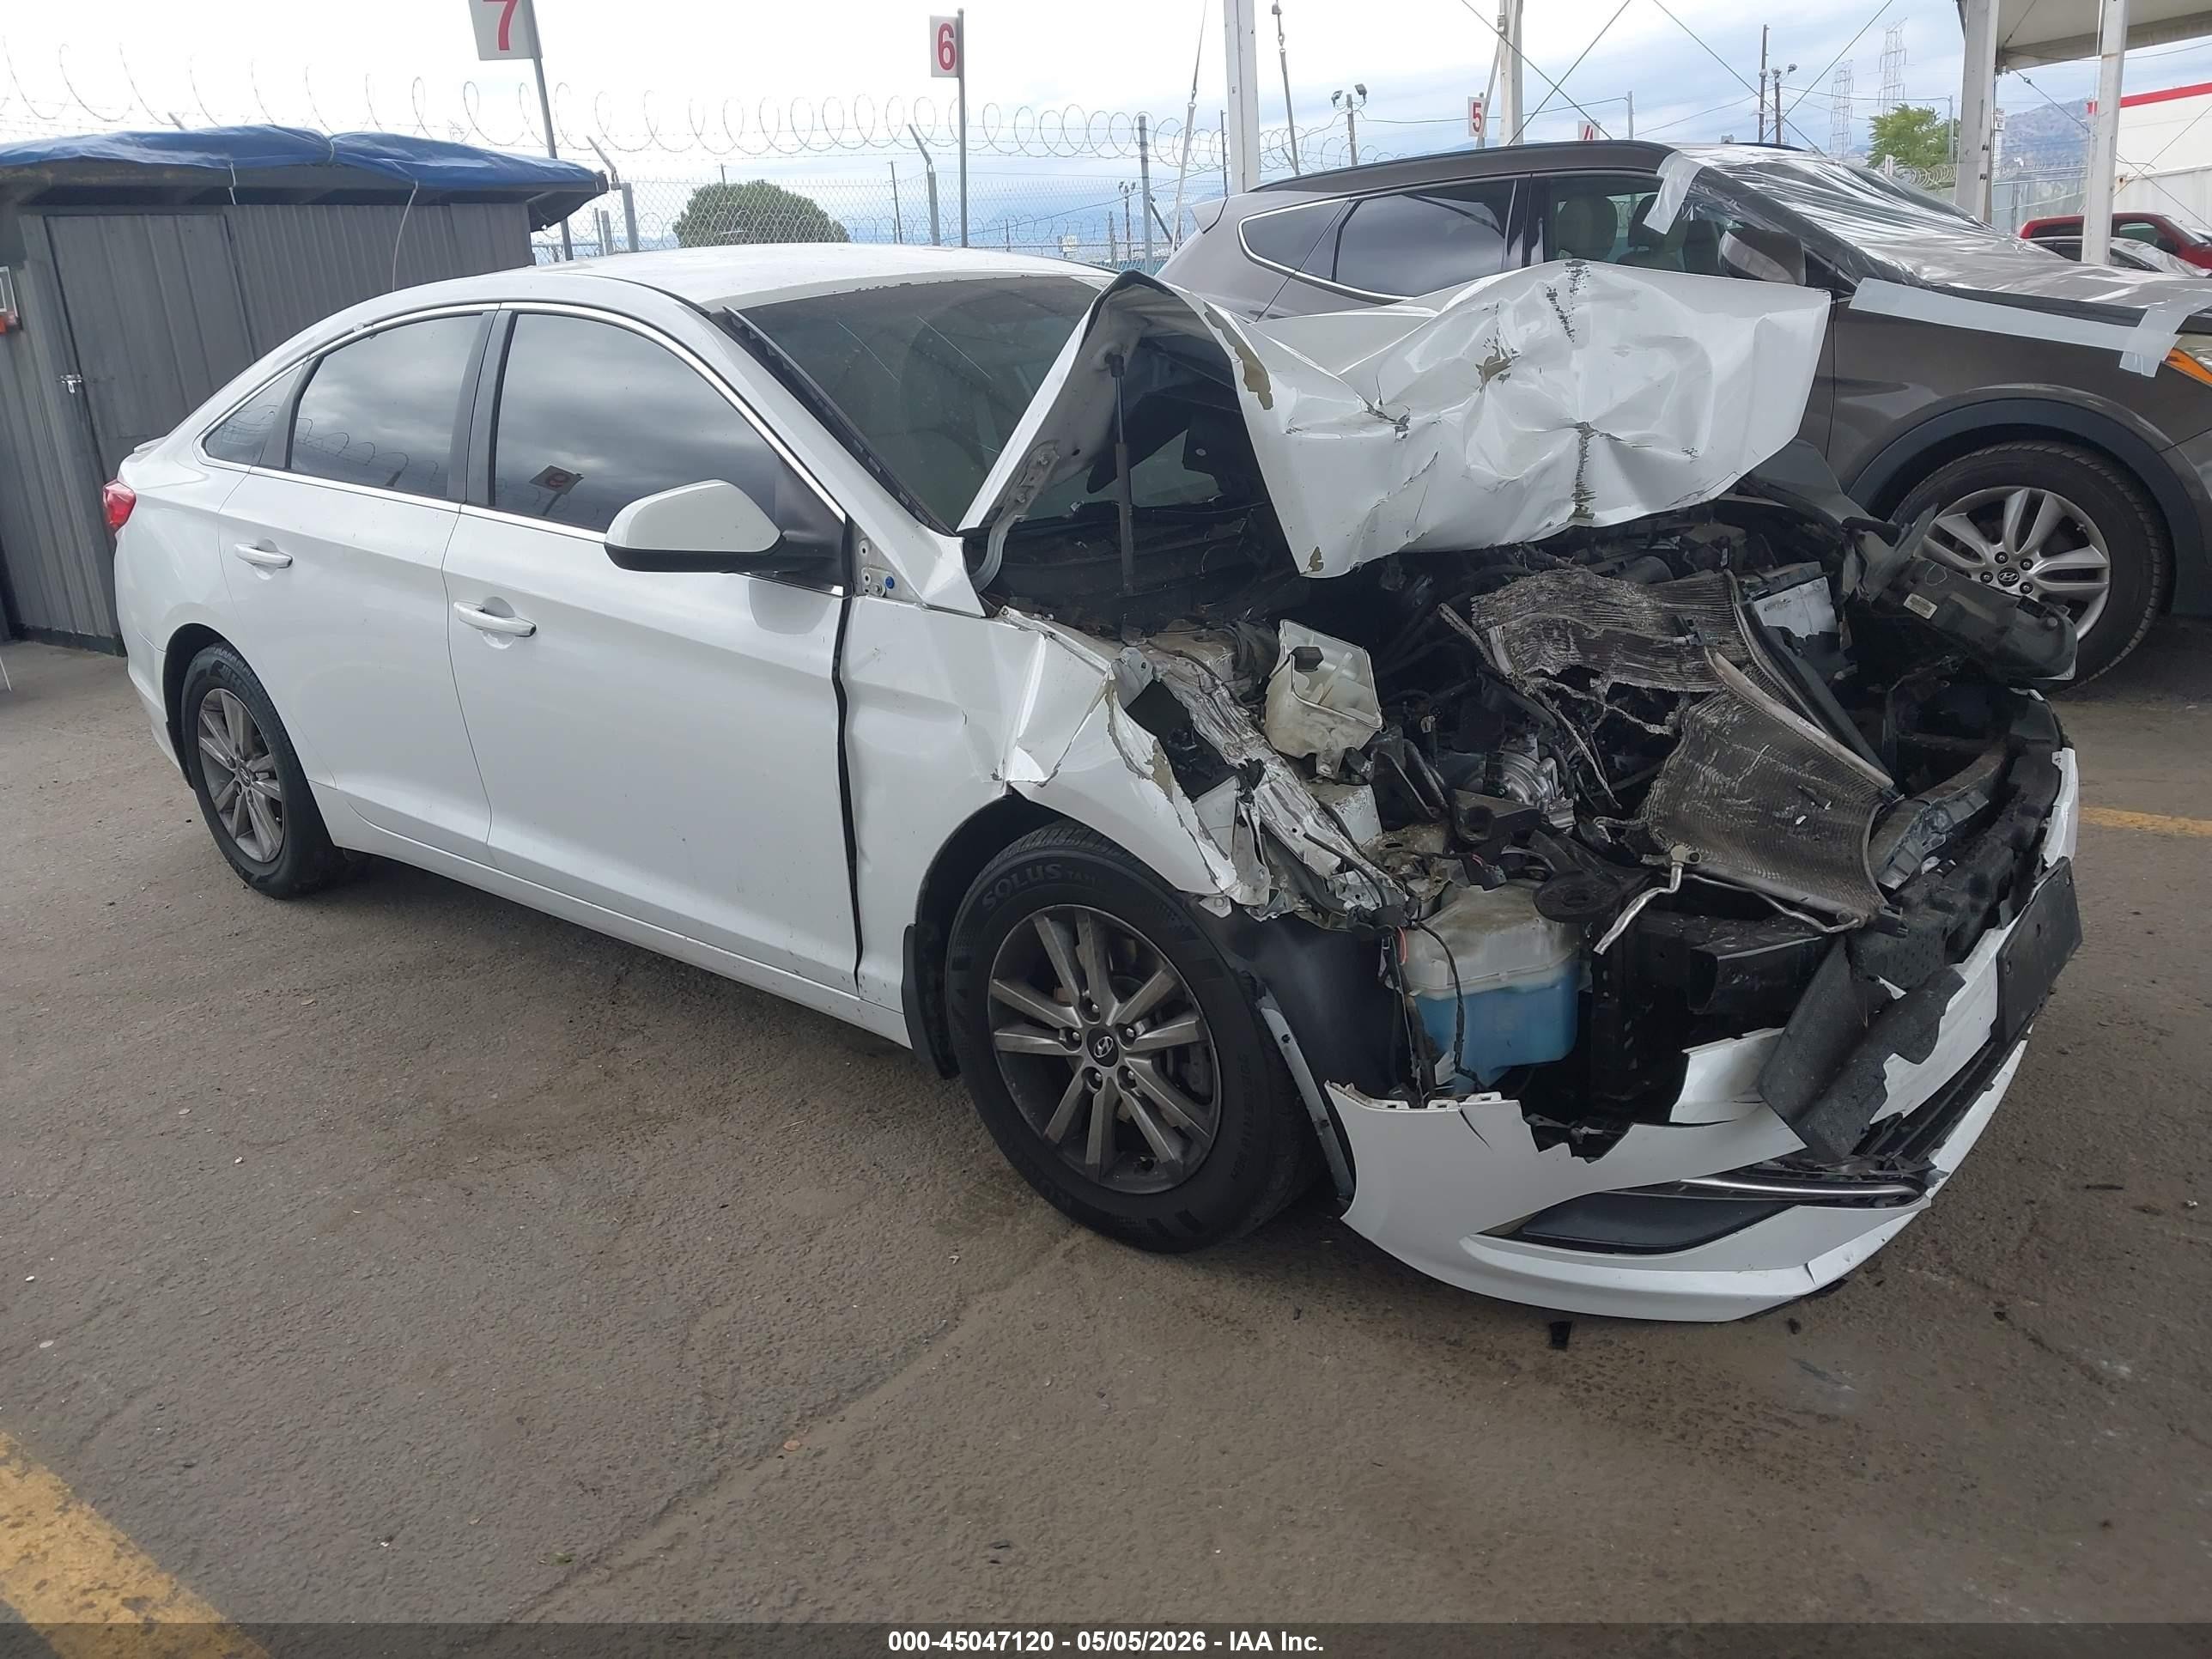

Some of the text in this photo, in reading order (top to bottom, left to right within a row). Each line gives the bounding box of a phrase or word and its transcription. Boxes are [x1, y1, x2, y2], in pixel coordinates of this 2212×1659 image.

[483, 0, 519, 51] 7
[938, 22, 956, 70] 6
[1472, 101, 1482, 132] 5
[981, 863, 1063, 910] SOLUS
